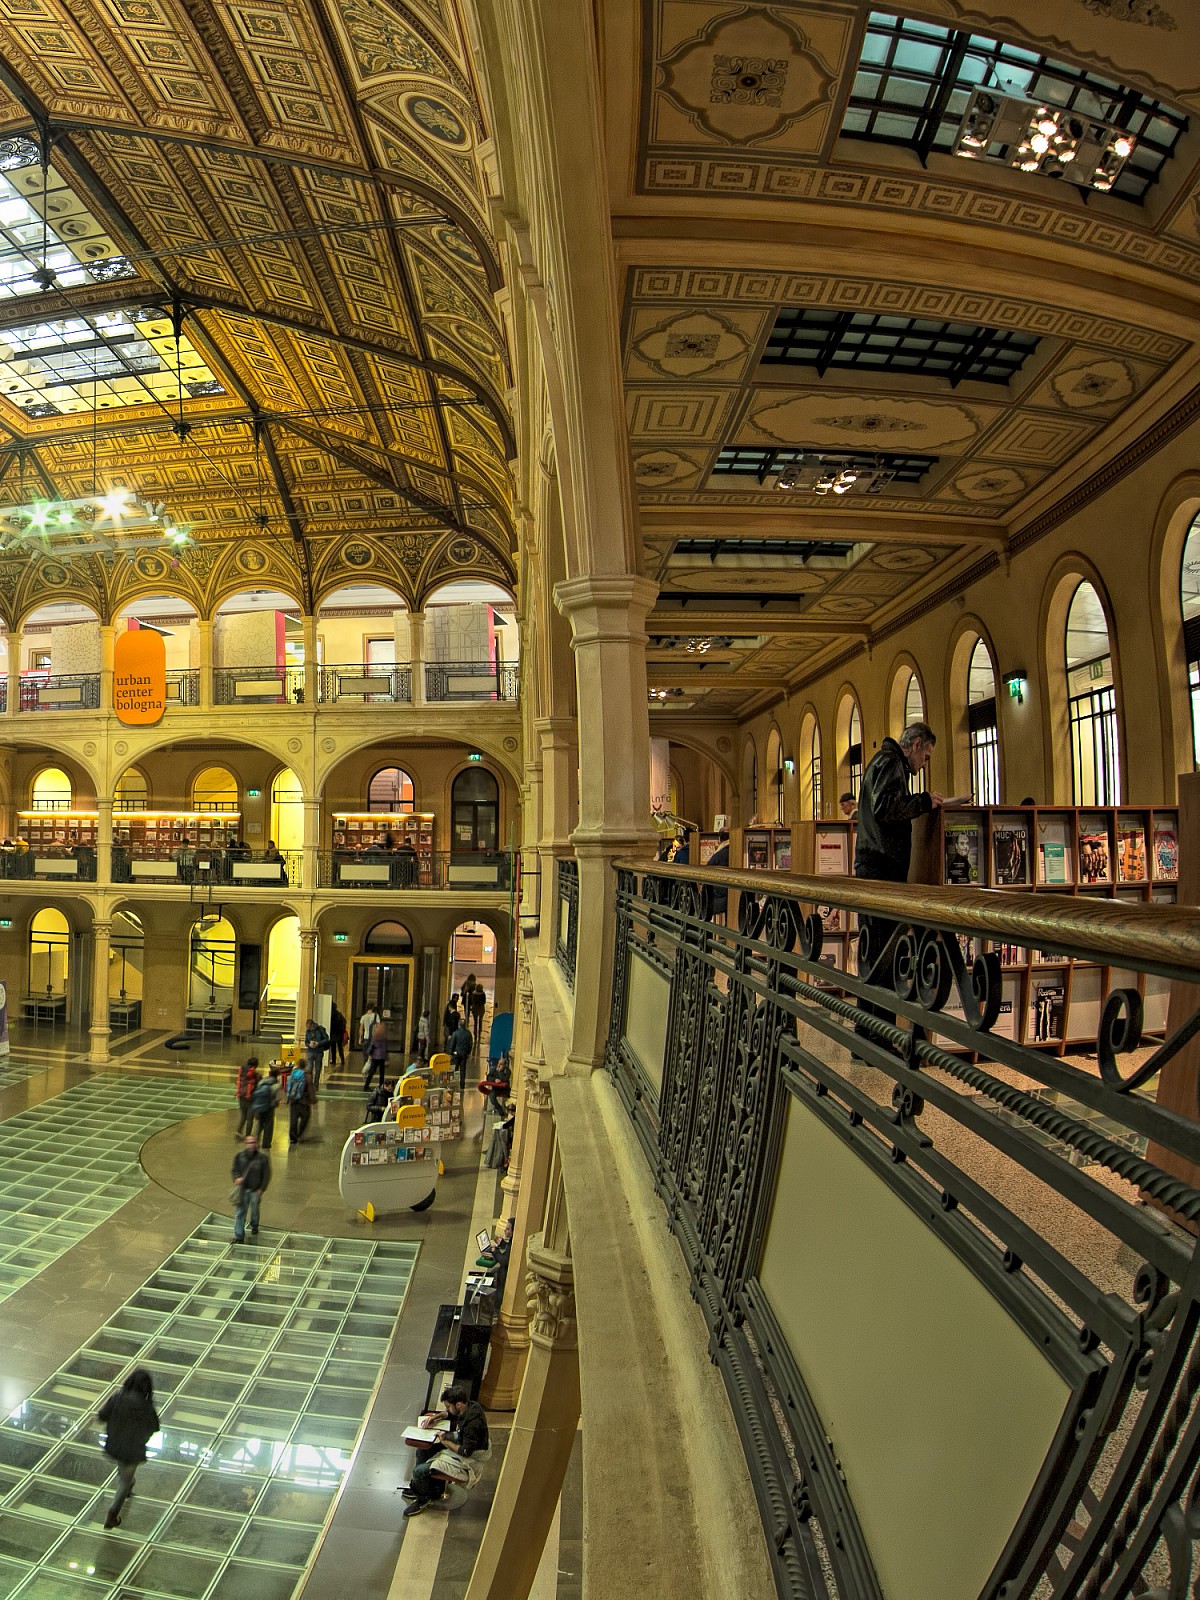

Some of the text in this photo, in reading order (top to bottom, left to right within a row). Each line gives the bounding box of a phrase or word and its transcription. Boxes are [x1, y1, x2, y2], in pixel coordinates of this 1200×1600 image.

[116, 674, 151, 686] urban
[116, 688, 153, 698] center
[116, 698, 162, 712] bologna
[651, 794, 672, 803] info
[994, 830, 1026, 839] MUCHIO
